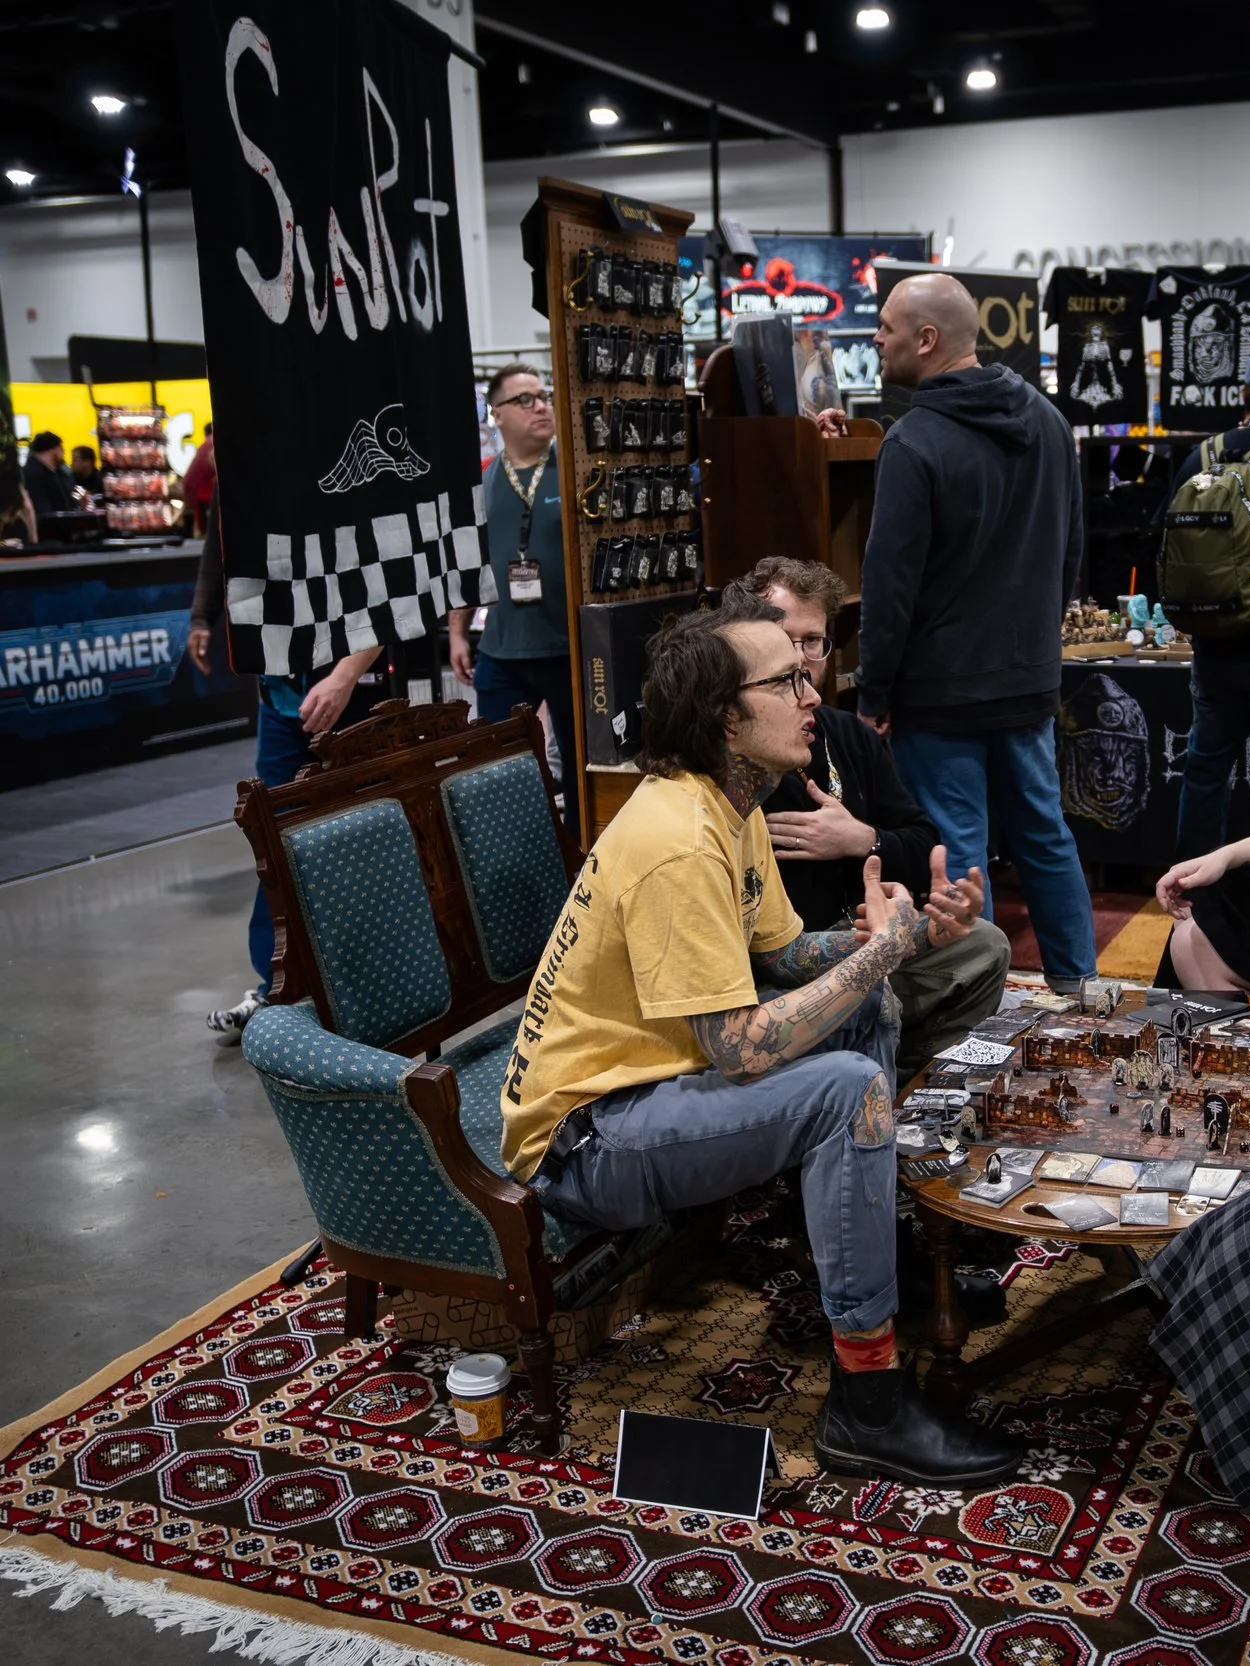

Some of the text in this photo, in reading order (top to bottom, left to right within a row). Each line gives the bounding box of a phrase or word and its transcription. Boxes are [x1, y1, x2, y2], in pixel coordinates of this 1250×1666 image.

[977, 291, 1036, 349] ot
[1169, 385, 1217, 407] FK
[592, 656, 609, 715] sun rot
